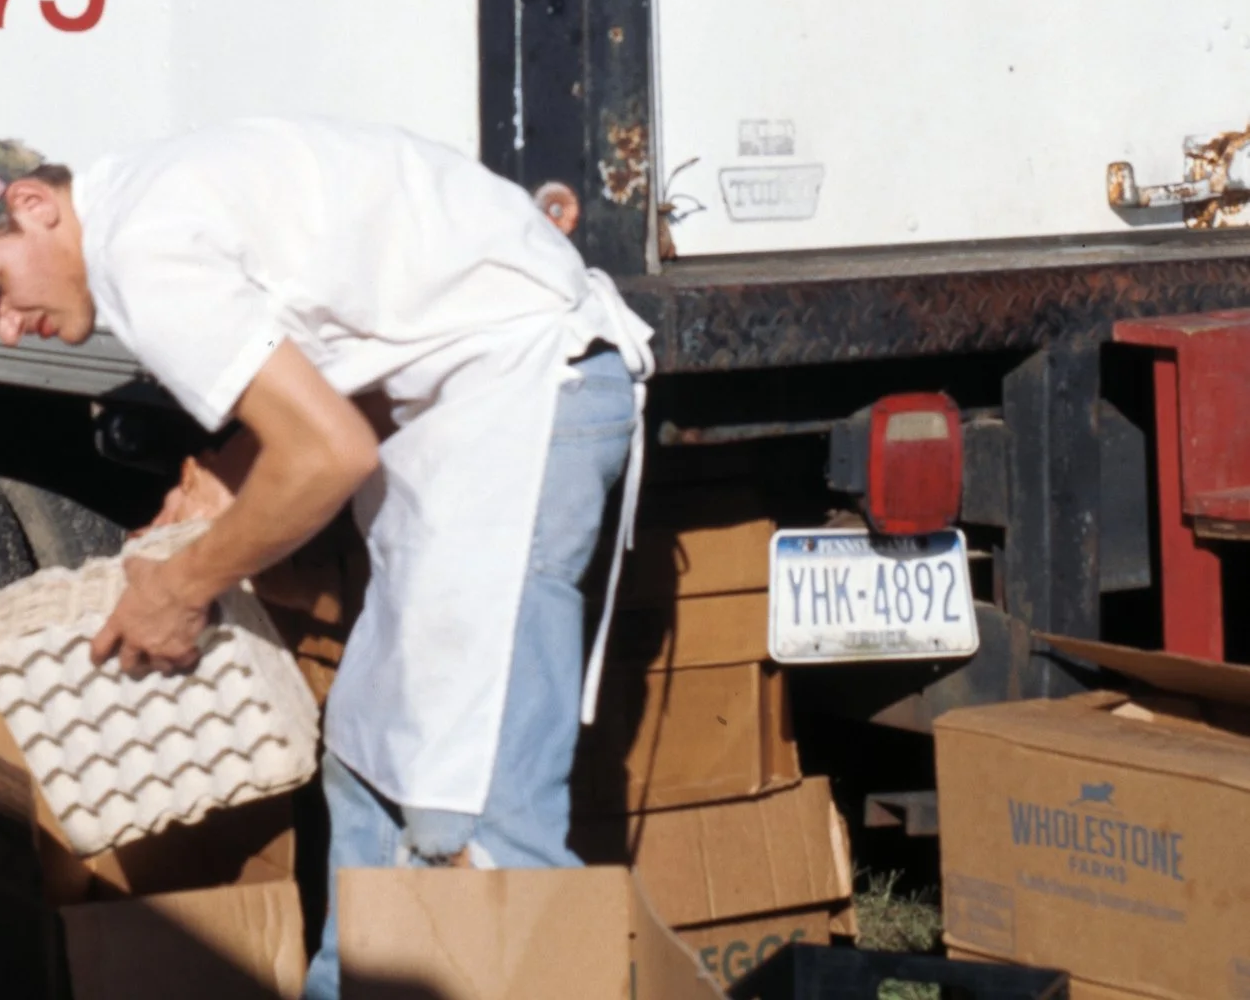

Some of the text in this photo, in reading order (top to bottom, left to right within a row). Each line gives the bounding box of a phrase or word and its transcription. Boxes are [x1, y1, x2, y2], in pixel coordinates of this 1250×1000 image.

[787, 560, 961, 626] YHK-4892
[1007, 798, 1185, 881] WHOLESTONE
[1068, 856, 1128, 885] FARMS
